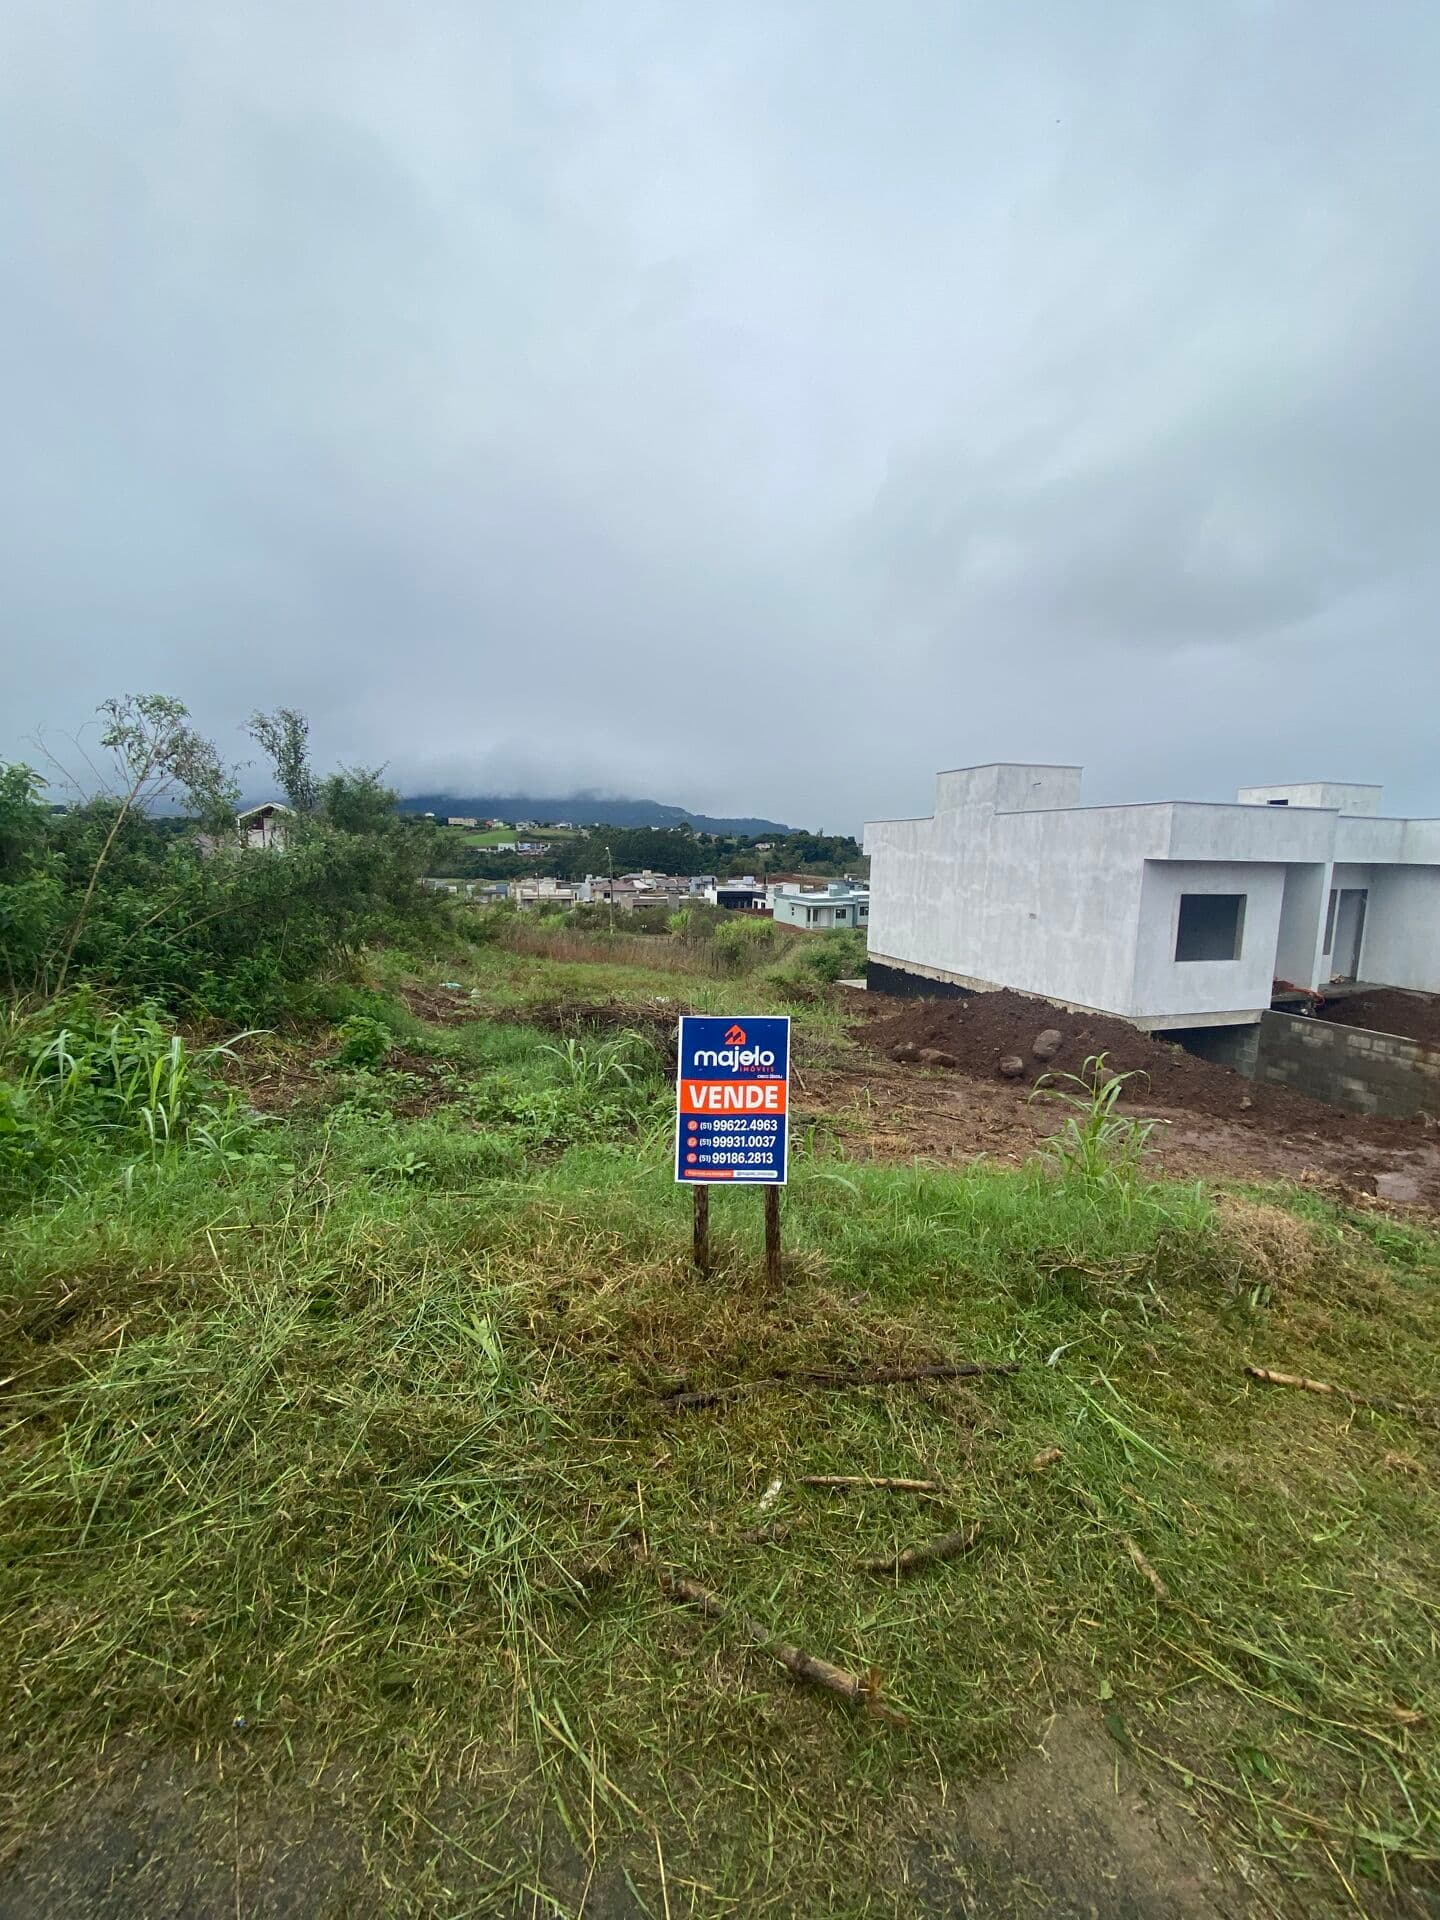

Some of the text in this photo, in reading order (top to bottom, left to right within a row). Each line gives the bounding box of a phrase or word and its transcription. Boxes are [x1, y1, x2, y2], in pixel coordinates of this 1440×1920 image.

[689, 1085, 778, 1109] VENDE
[700, 1119, 777, 1131] (51) 99622.4963
[699, 1136, 776, 1148] (51) 99931.0037
[699, 1152, 773, 1164] (51) 99186.2813
